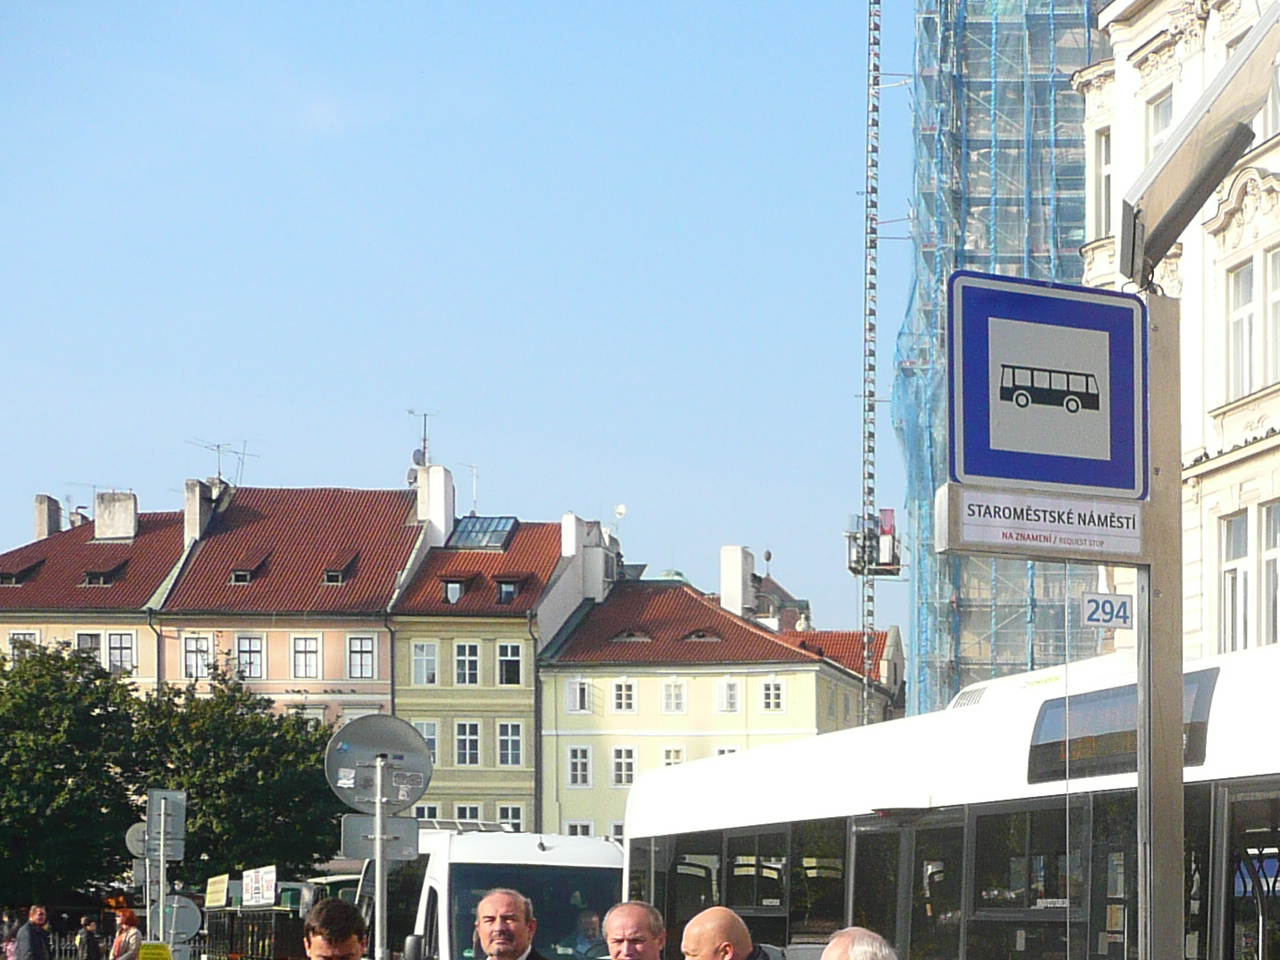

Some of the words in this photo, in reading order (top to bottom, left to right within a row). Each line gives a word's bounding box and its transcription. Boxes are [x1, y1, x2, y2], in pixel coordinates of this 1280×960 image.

[967, 503, 1074, 525] STAROMĚSTSKÉ
[1077, 510, 1136, 530] NÁMĚSTÍ
[1002, 531, 1014, 541] NA
[1015, 532, 1052, 543] ZNAMENÍ
[1059, 537, 1087, 546] REQUEST
[1088, 539, 1105, 548] STOP
[1087, 599, 1130, 624] 294
